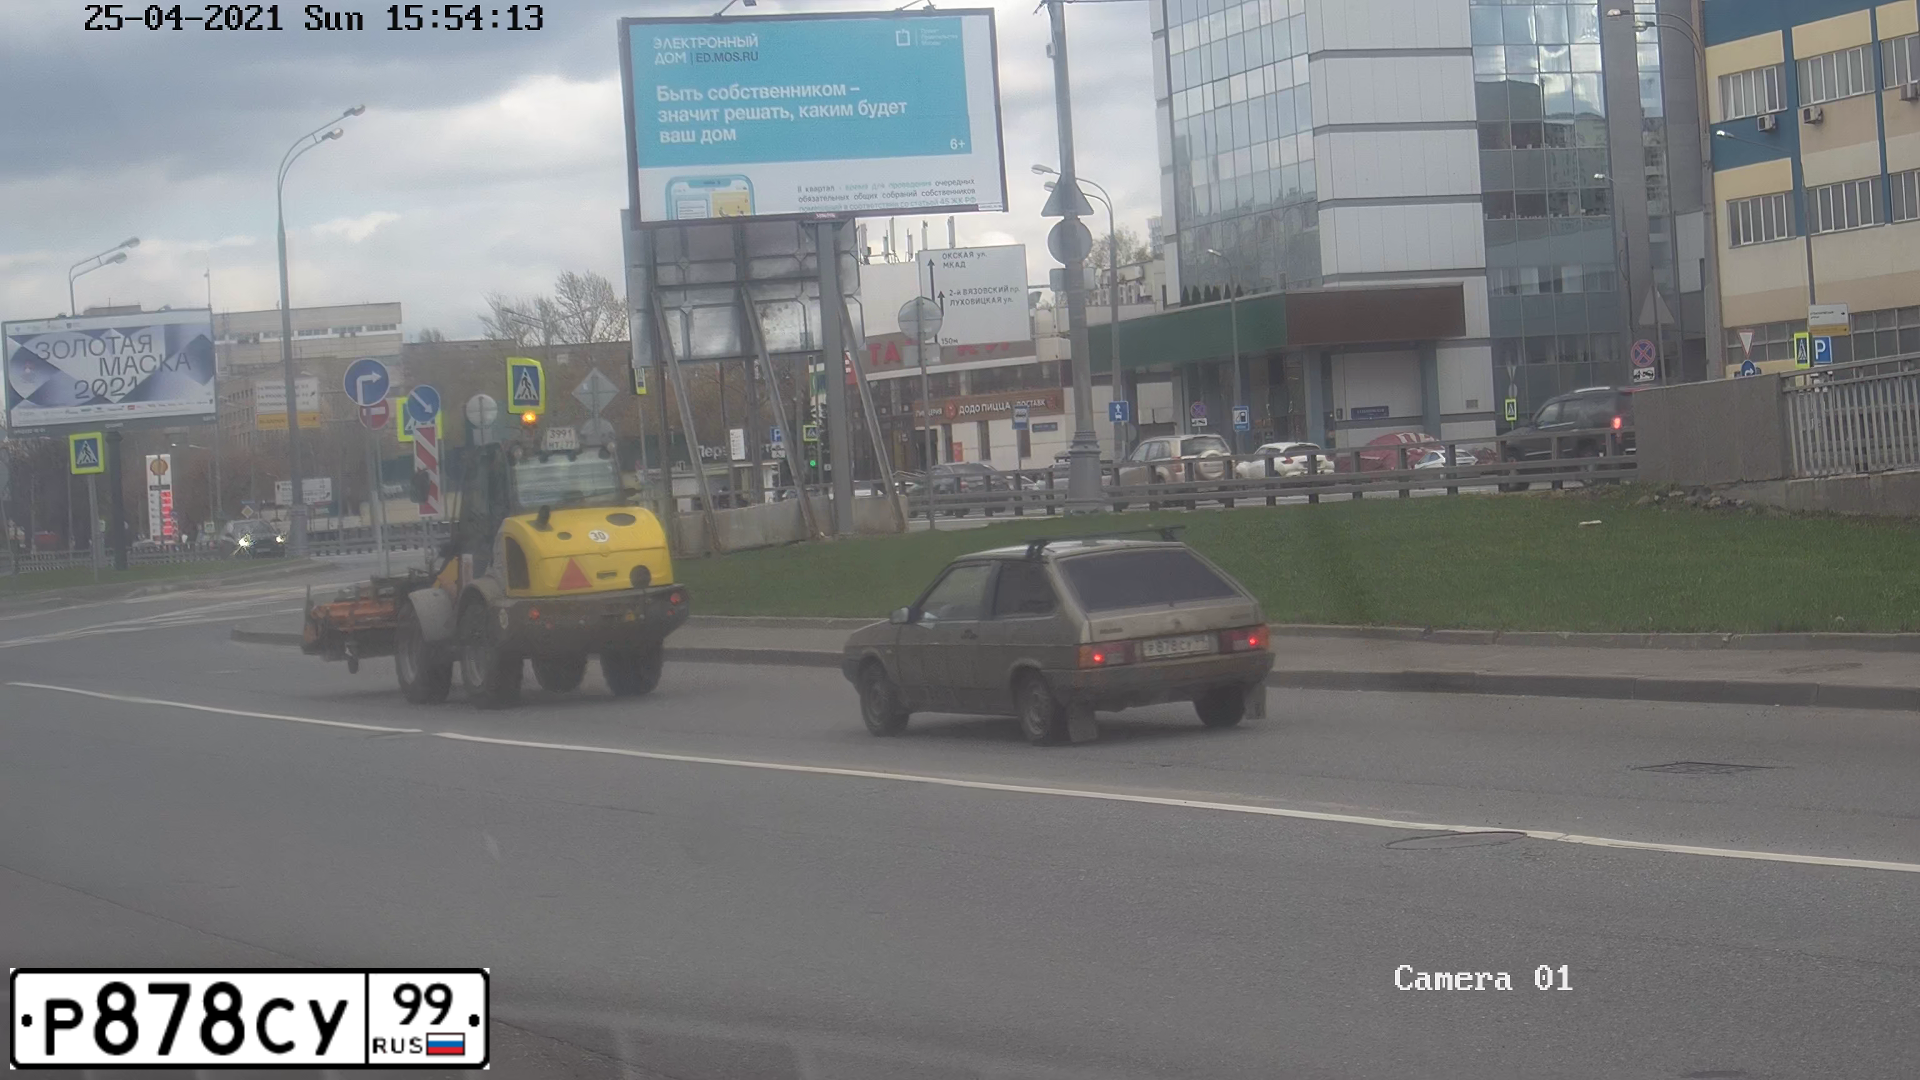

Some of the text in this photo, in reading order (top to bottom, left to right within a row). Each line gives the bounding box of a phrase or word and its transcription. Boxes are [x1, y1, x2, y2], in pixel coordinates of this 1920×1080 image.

[653, 33, 759, 49] ЭЛЕКТРОННЫЙ
[655, 50, 760, 66] ДОМ ED.MOS.RU
[656, 84, 703, 103] Быть
[708, 82, 846, 101] собственником
[658, 98, 907, 125] значит решать, каким будет
[660, 128, 736, 145] ваш дом
[949, 138, 966, 150] 6+
[805, 185, 835, 194] квартал
[934, 178, 975, 188] очередных
[798, 188, 976, 203] обязательных общих собраний собственников
[942, 251, 974, 260] ОКСКАЯ
[943, 261, 967, 269] МКАД
[963, 285, 1009, 296] ВЯЗОВСКИЙ
[950, 296, 1002, 307] ЛУХОВИЦКАЯ
[35, 334, 153, 360] ЗОЛОТАЯ
[100, 352, 192, 377] МАСКА
[74, 376, 139, 400] 2021
[958, 401, 1012, 416] ДОДО ПИЦЦА
[590, 531, 606, 541] 30
